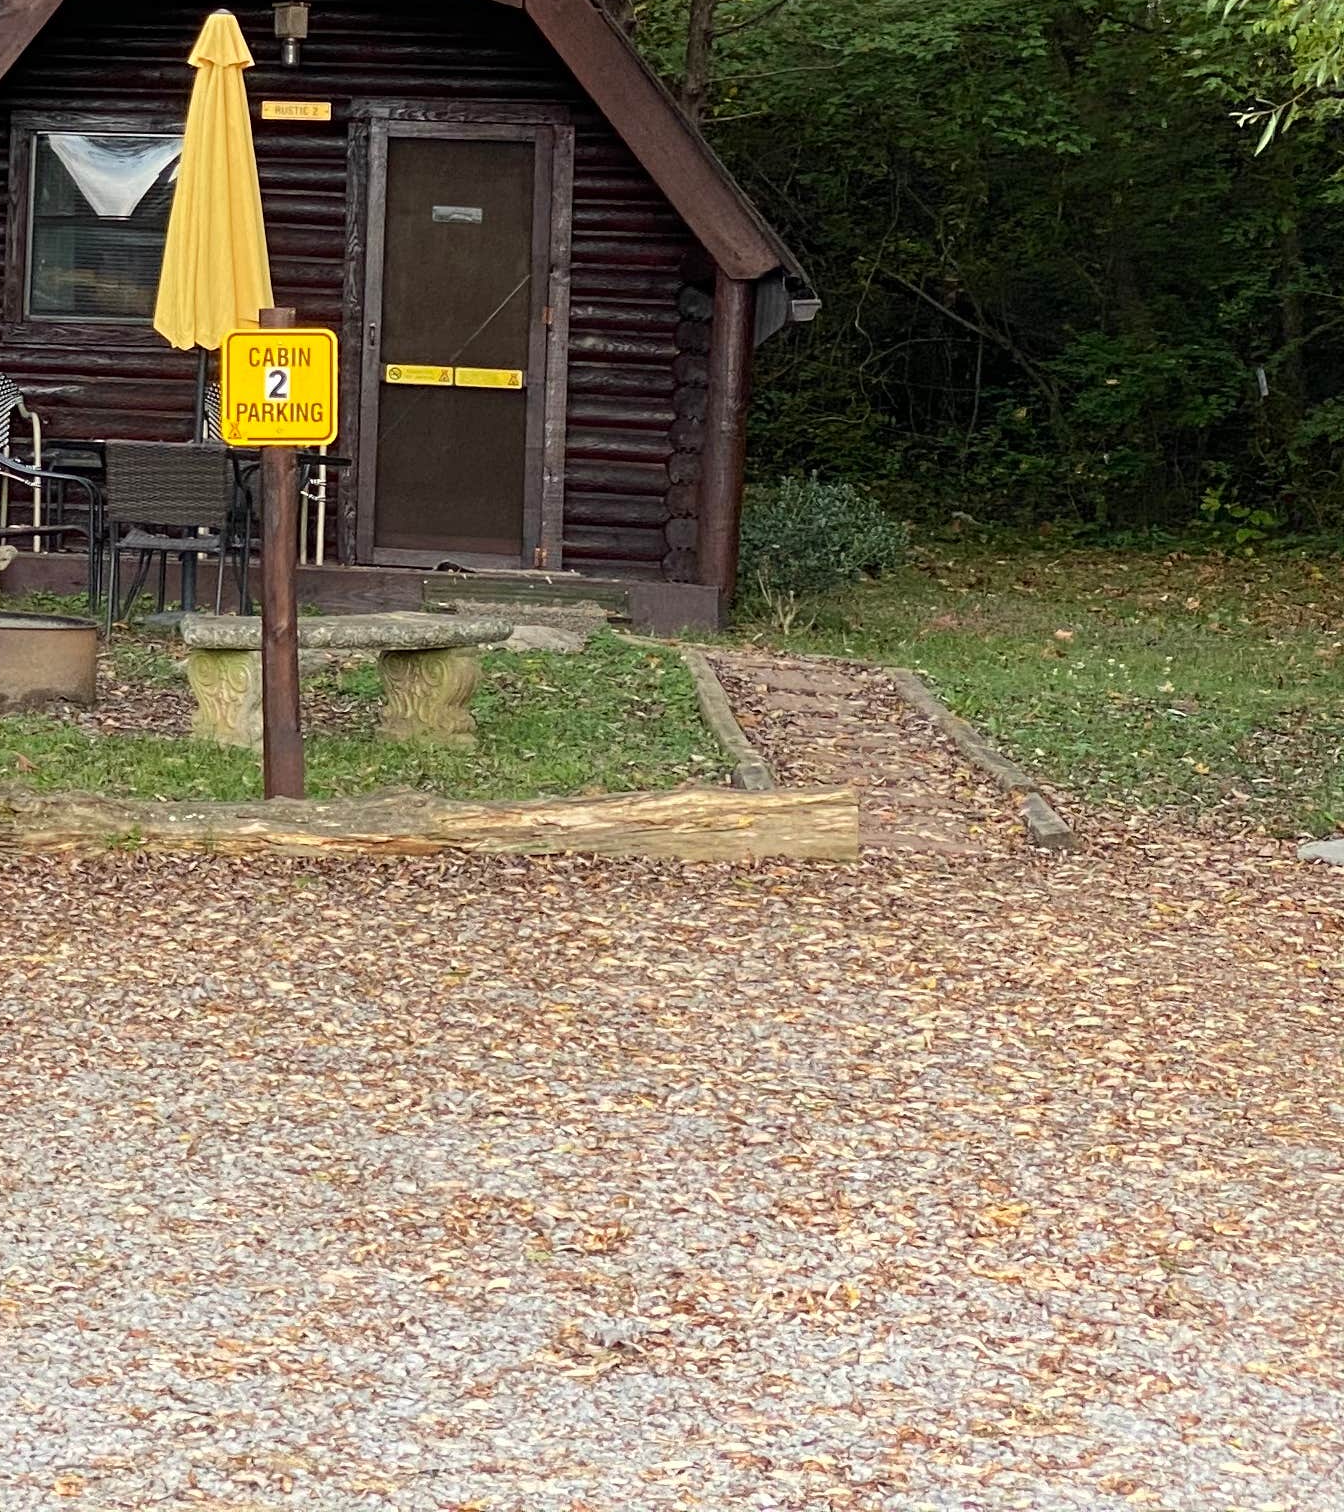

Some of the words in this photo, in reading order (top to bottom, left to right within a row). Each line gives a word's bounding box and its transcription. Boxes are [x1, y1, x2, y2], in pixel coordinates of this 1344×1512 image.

[275, 105, 309, 116] RUSTIC
[312, 106, 319, 116] 2
[249, 347, 311, 367] CABIN
[268, 369, 288, 399] 2
[236, 402, 323, 423] PARKING
